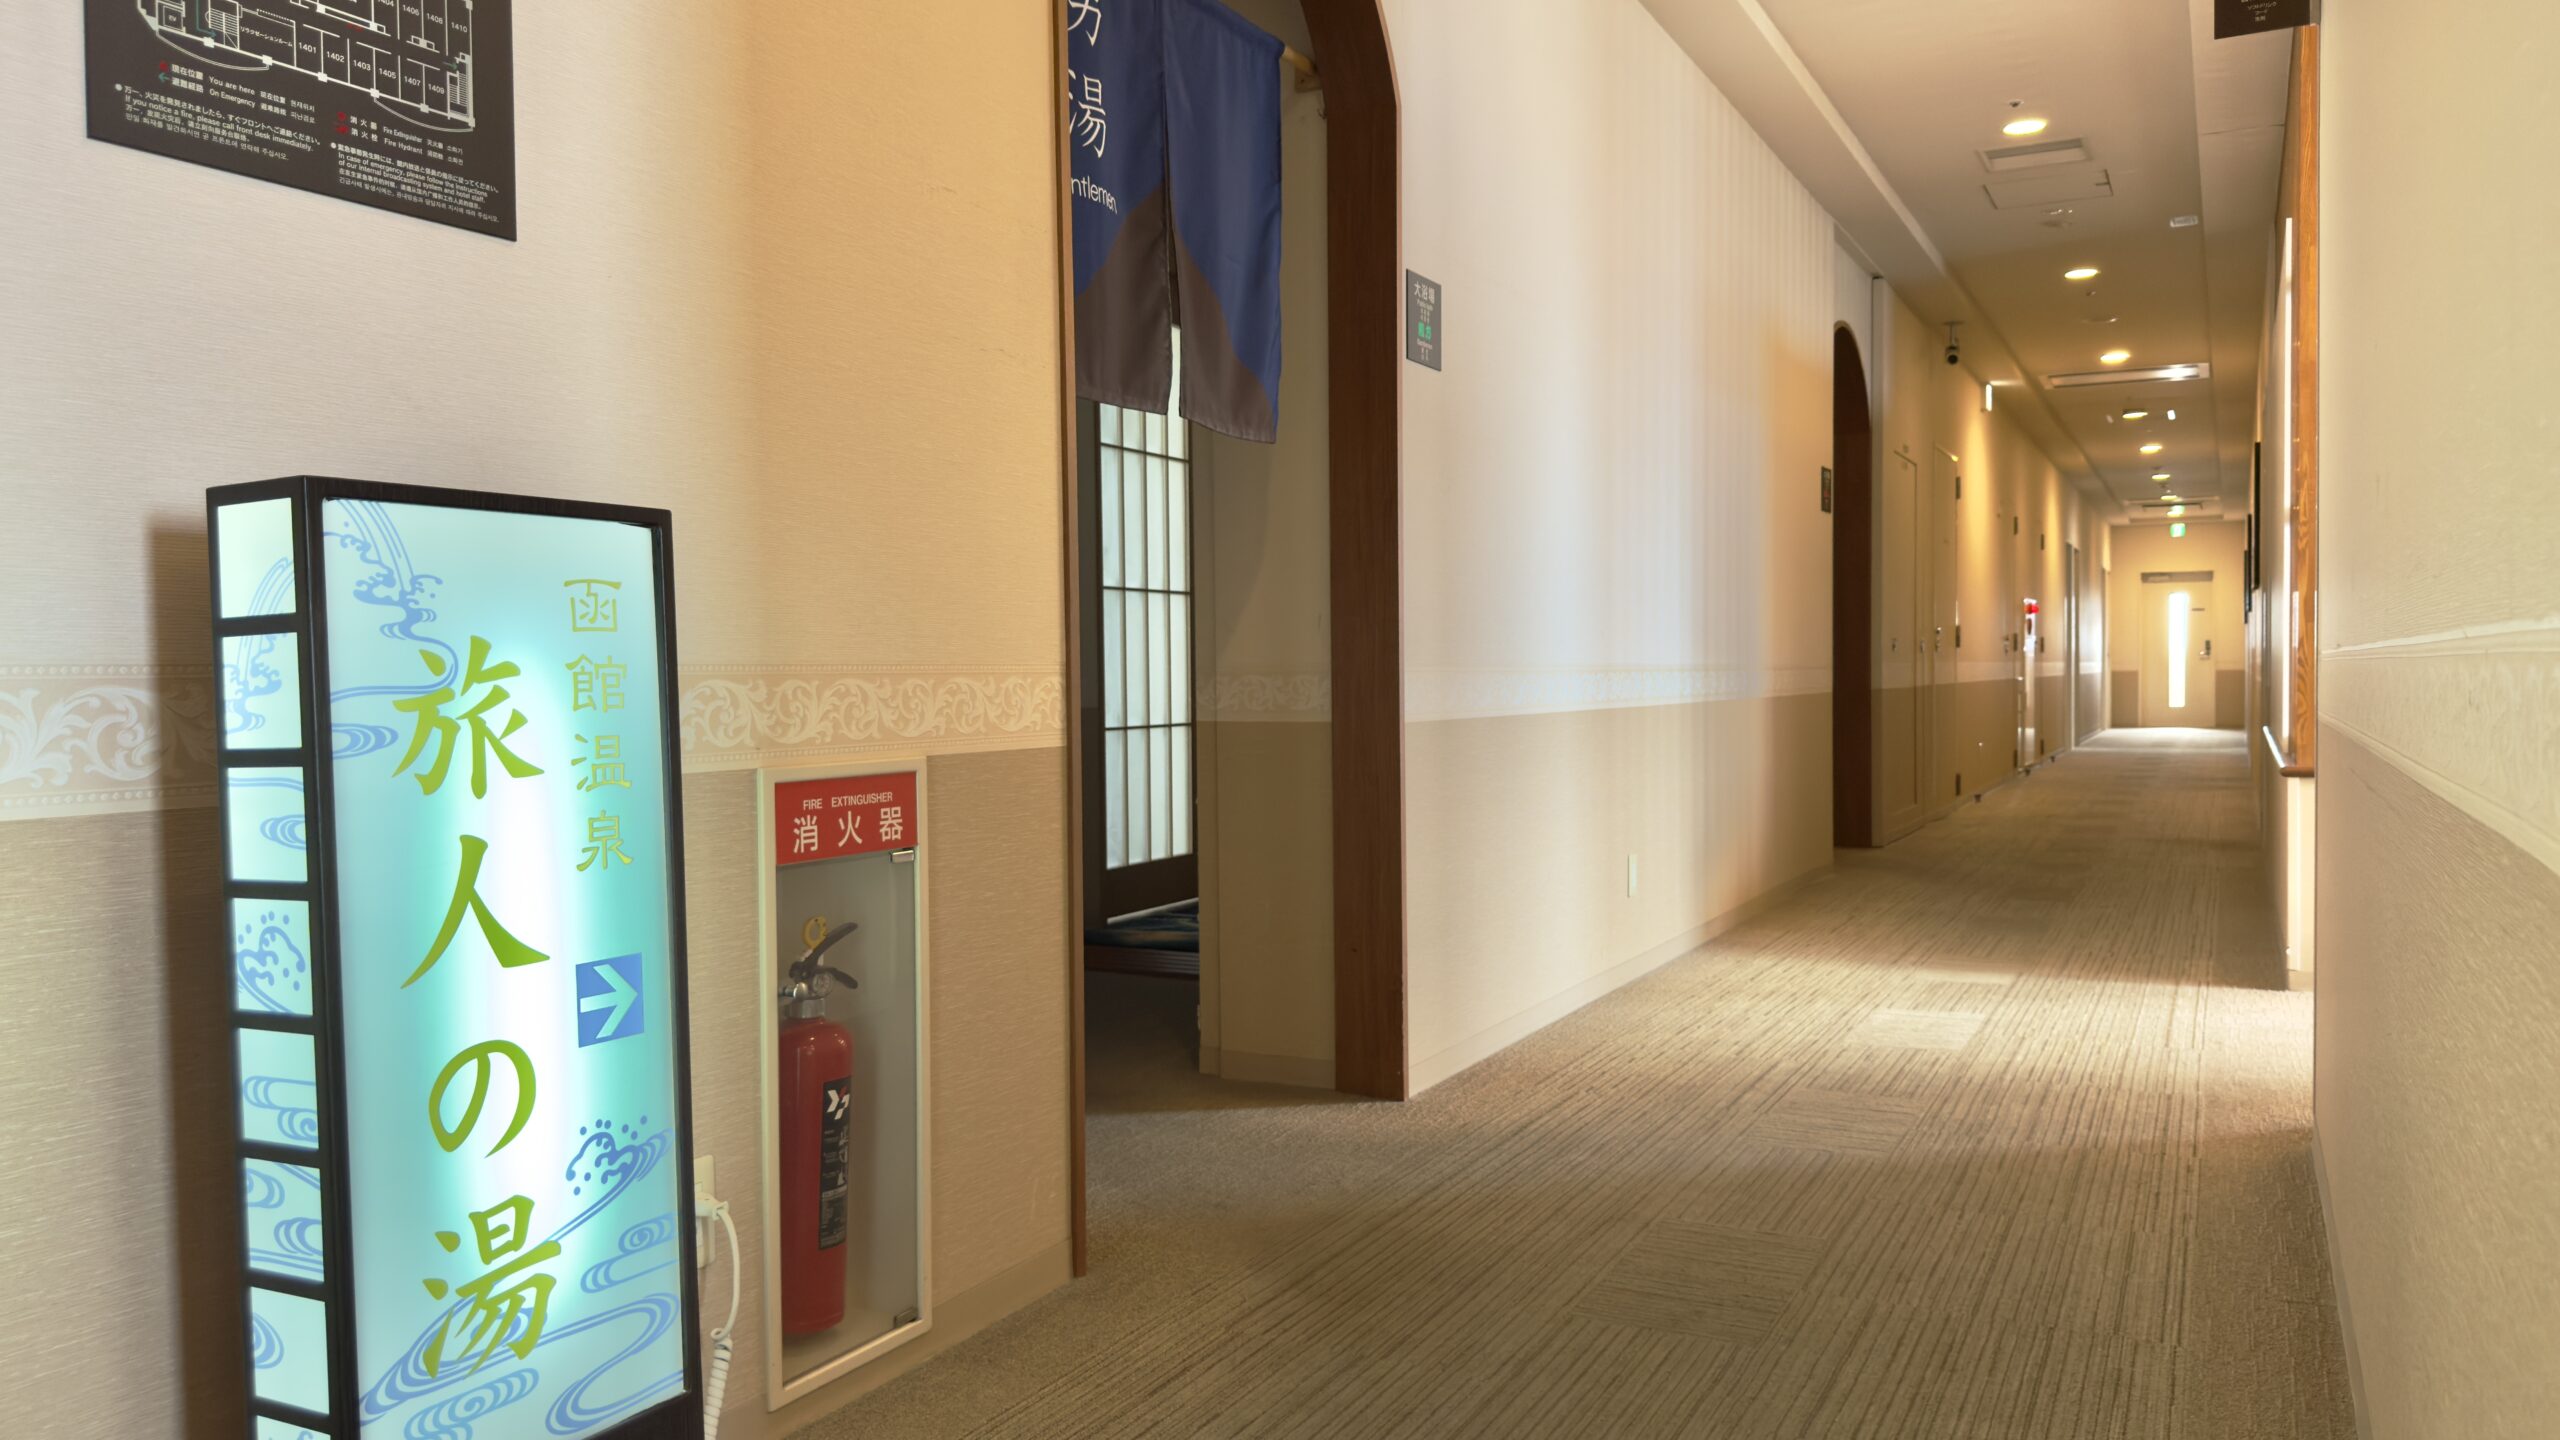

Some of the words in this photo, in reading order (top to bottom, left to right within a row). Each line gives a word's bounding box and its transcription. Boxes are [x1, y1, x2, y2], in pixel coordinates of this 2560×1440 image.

[402, 4, 420, 16] 1406
[451, 22, 468, 33] 1410
[299, 42, 317, 54] 1401
[326, 51, 345, 63] 1402
[353, 60, 371, 72] 1403
[378, 67, 397, 80] 1405
[209, 76, 223, 86] You
[225, 81, 237, 90] are
[239, 84, 255, 95] here
[404, 76, 421, 87] 1407
[428, 83, 445, 95] 1409
[209, 88, 220, 98] On
[221, 91, 256, 108] Emergency
[133, 98, 147, 107] you
[149, 101, 172, 114] notice
[197, 115, 221, 127] please
[222, 121, 235, 130] call
[236, 124, 253, 135] front
[255, 129, 271, 140] desk
[383, 126, 393, 135] Fire
[384, 138, 397, 147] Fire
[398, 140, 423, 154] Hydrant
[346, 154, 361, 163] case
[1071, 175, 1117, 215] ntlemen
[563, 578, 634, 873] 函館温泉
[803, 798, 823, 811] FIRE
[831, 791, 893, 808] EXTINGUISHER
[793, 806, 903, 853] 消火器
[391, 633, 561, 1378] 旅人の湯
